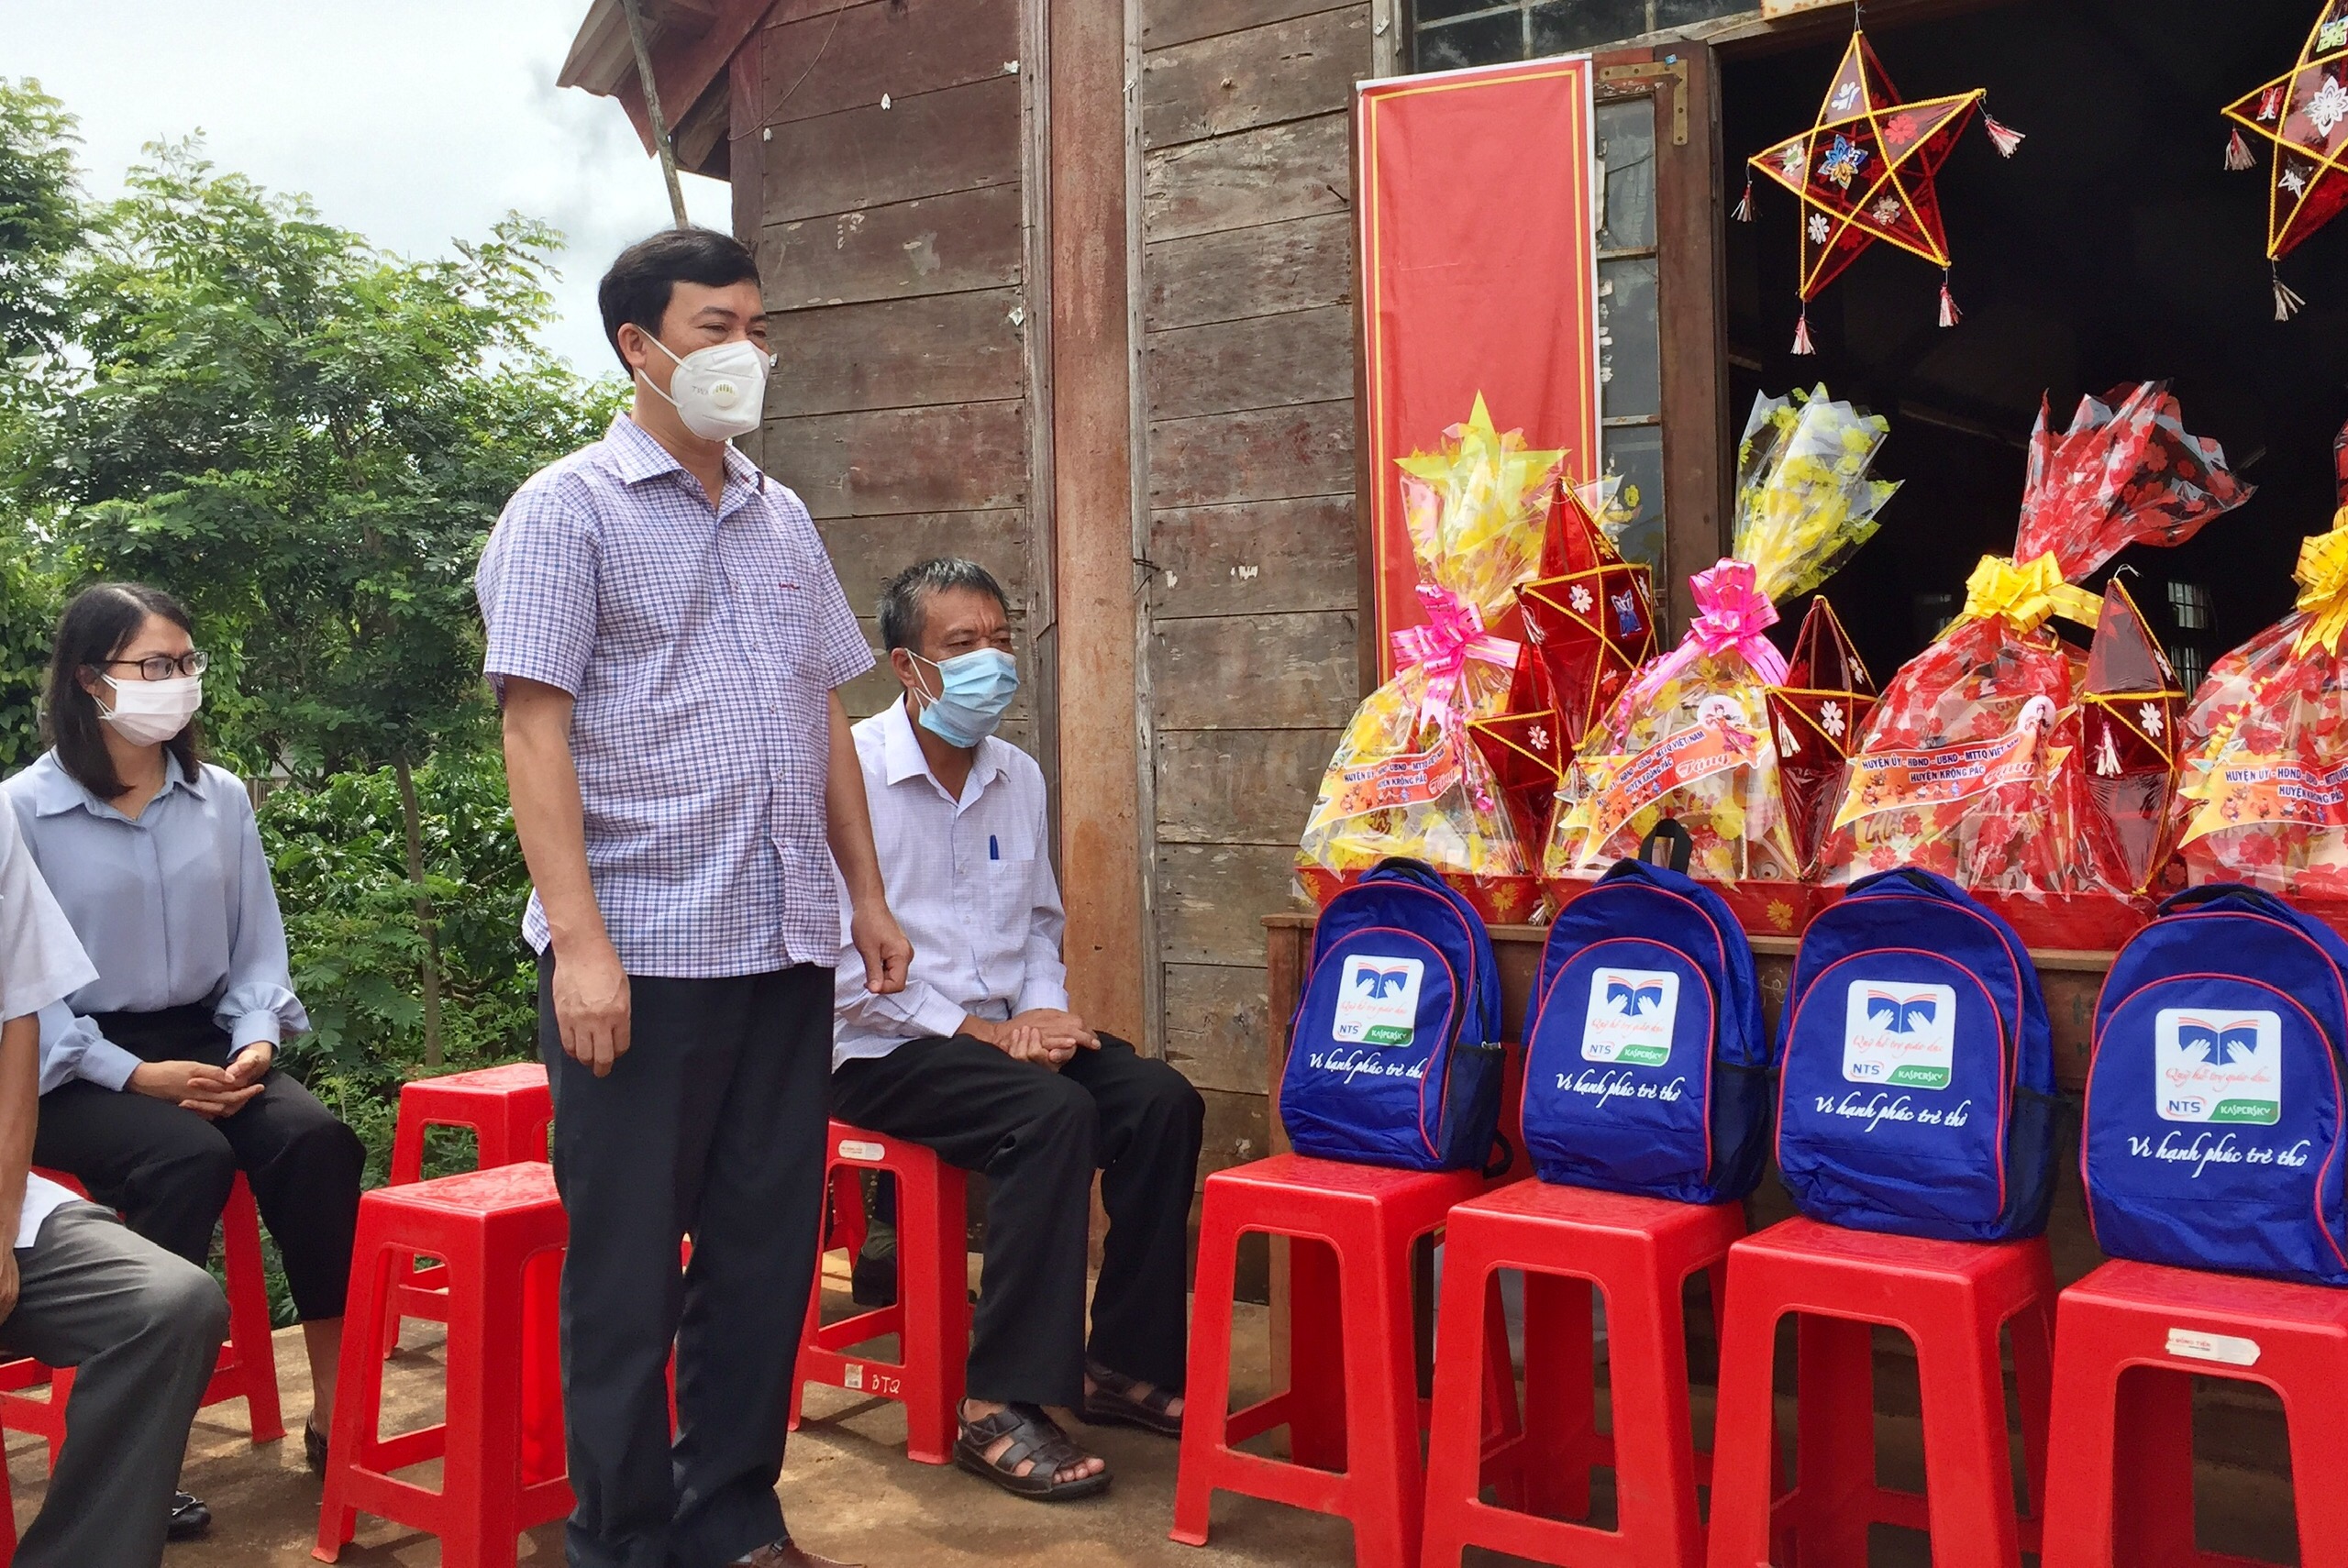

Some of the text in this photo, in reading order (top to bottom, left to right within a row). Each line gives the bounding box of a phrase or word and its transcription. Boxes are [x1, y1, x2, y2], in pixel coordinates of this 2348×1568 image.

[1862, 756, 1889, 768] HUYỆN
[1937, 754, 1958, 765] UBND
[1966, 750, 1988, 760] MTTQ
[1911, 769, 1937, 782] HUYỆN
[2225, 768, 2256, 781] HUYỆN
[2277, 767, 2301, 779] HĐND
[2279, 784, 2306, 798] HUYỆN
[1339, 1024, 1359, 1034] NTS
[1589, 1043, 1611, 1055] NTS
[1853, 1063, 1880, 1076] NTS
[1573, 1068, 1616, 1095] hạnh
[1596, 1071, 1634, 1109] phúc
[1835, 1091, 1888, 1120] hạnh
[1865, 1095, 1915, 1132] phúc
[2169, 1099, 2201, 1113] NTS
[2155, 1131, 2212, 1163] hạnh
[2192, 1132, 2243, 1178] phúc
[2246, 1147, 2274, 1165] trẻ
[2276, 1140, 2311, 1167] thơ
